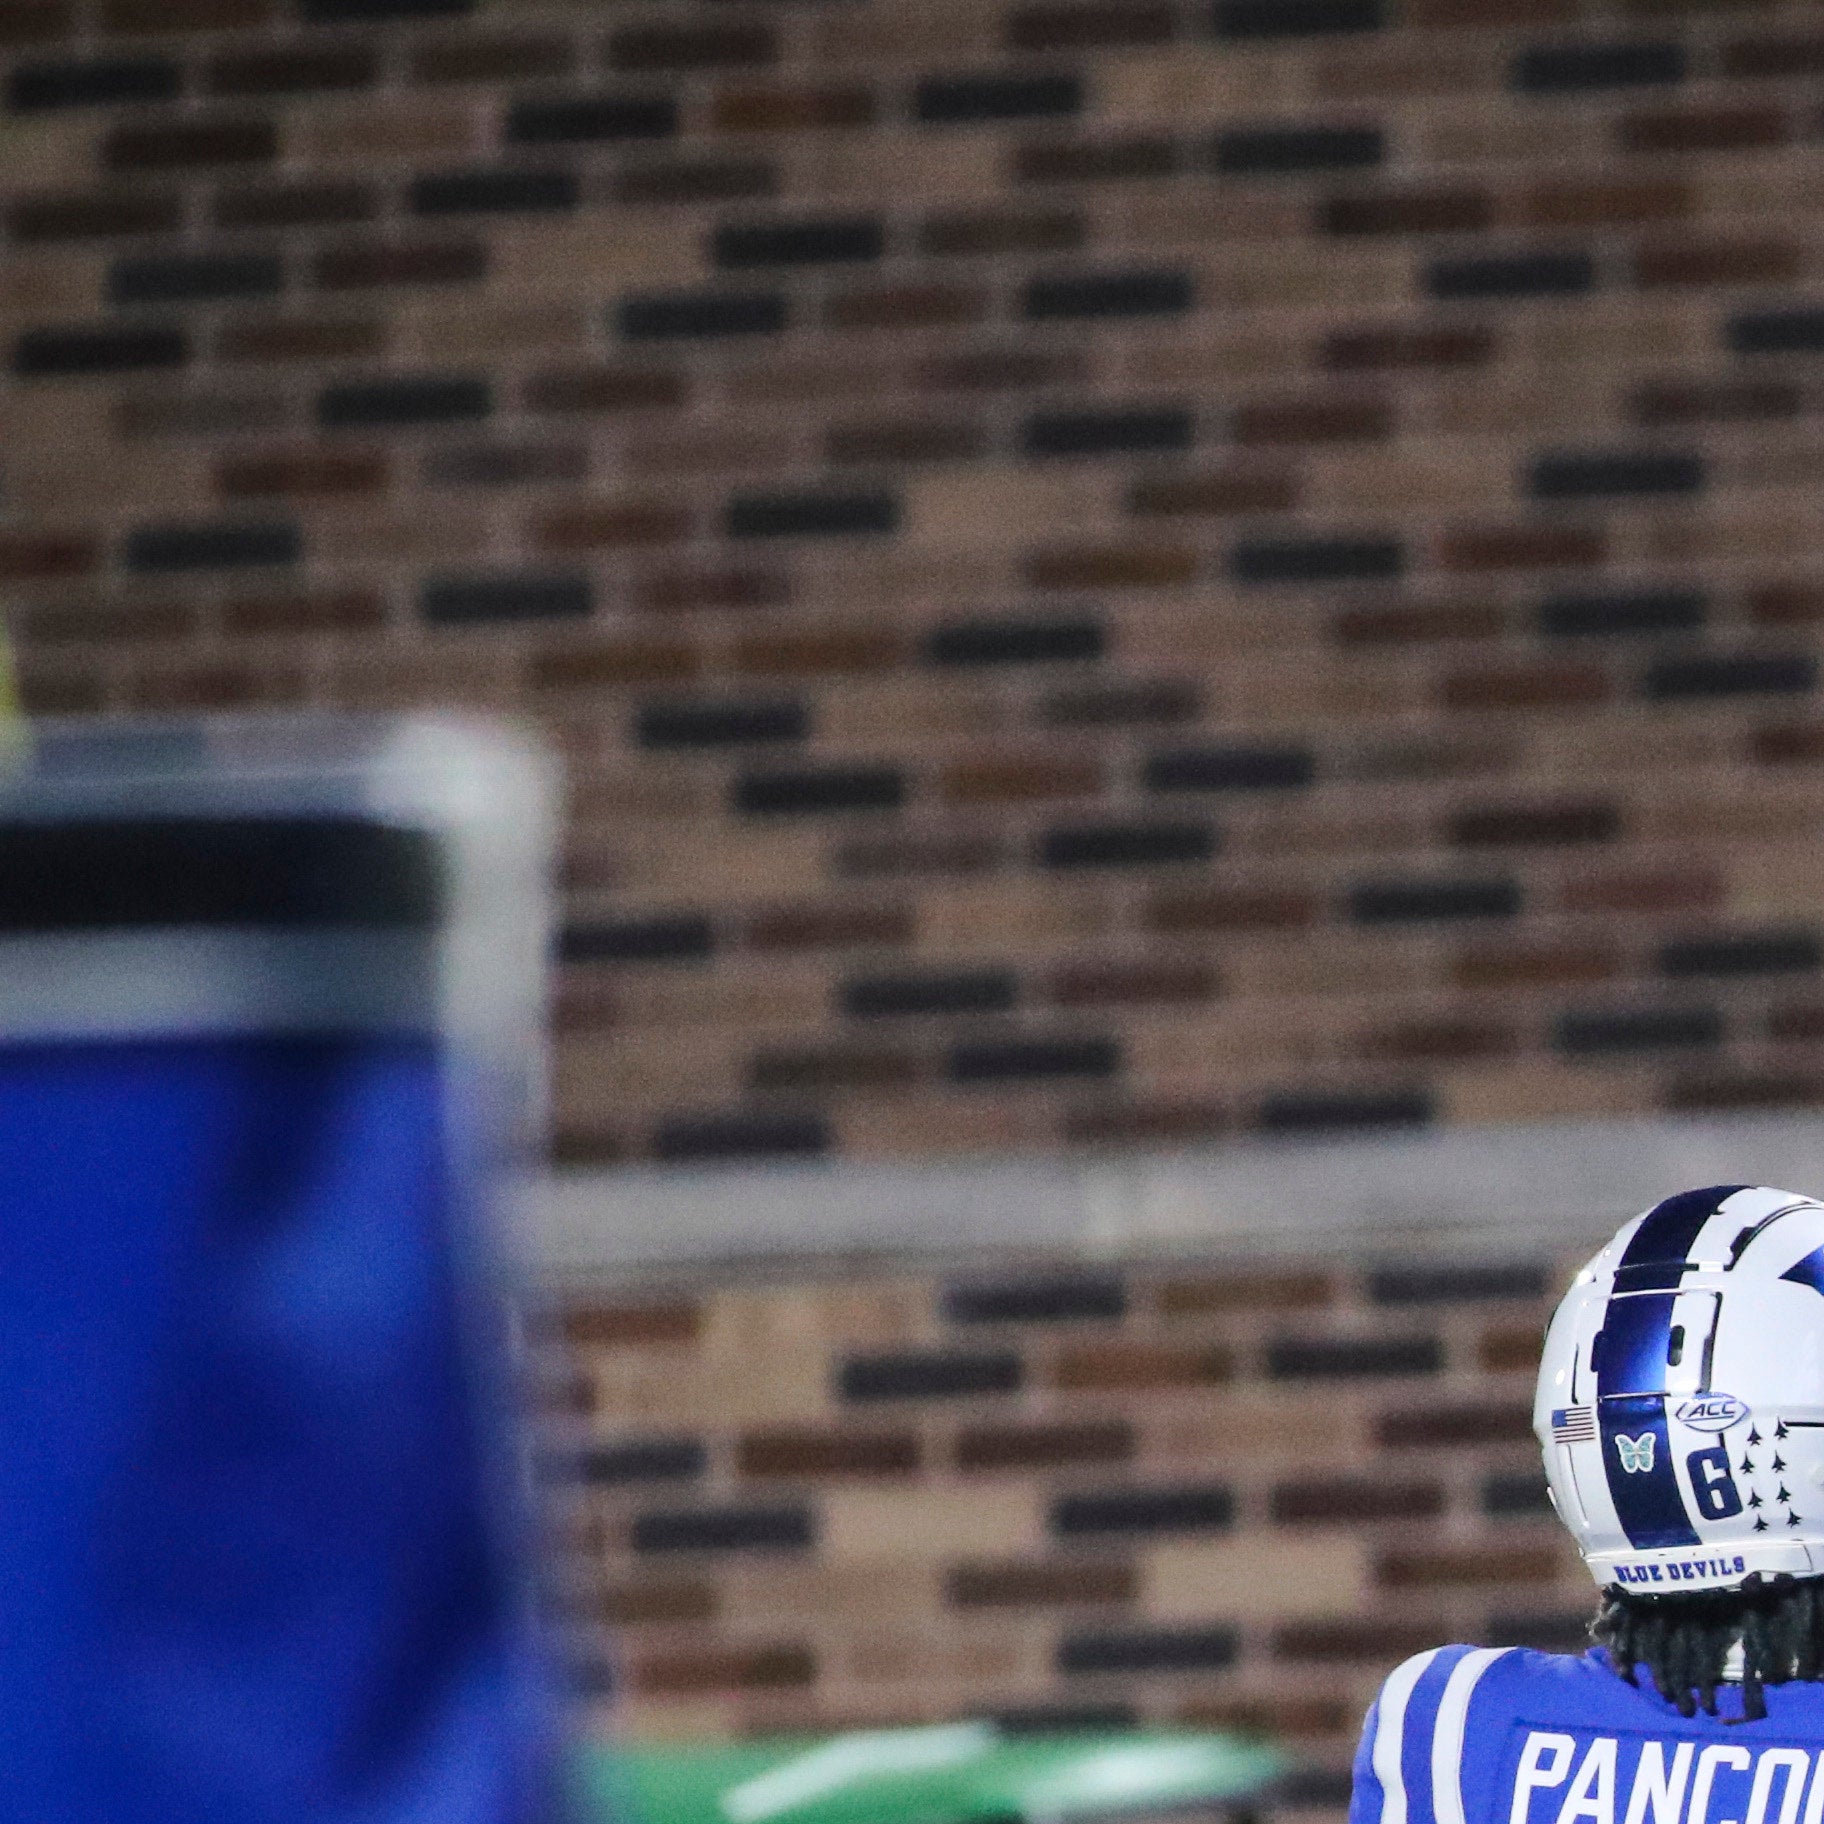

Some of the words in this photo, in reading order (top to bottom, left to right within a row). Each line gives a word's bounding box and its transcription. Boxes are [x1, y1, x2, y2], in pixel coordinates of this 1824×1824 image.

[1686, 1446, 1744, 1521] 6
[1614, 1564, 1664, 1583] BLUE
[1666, 1556, 1746, 1580] DEVILS
